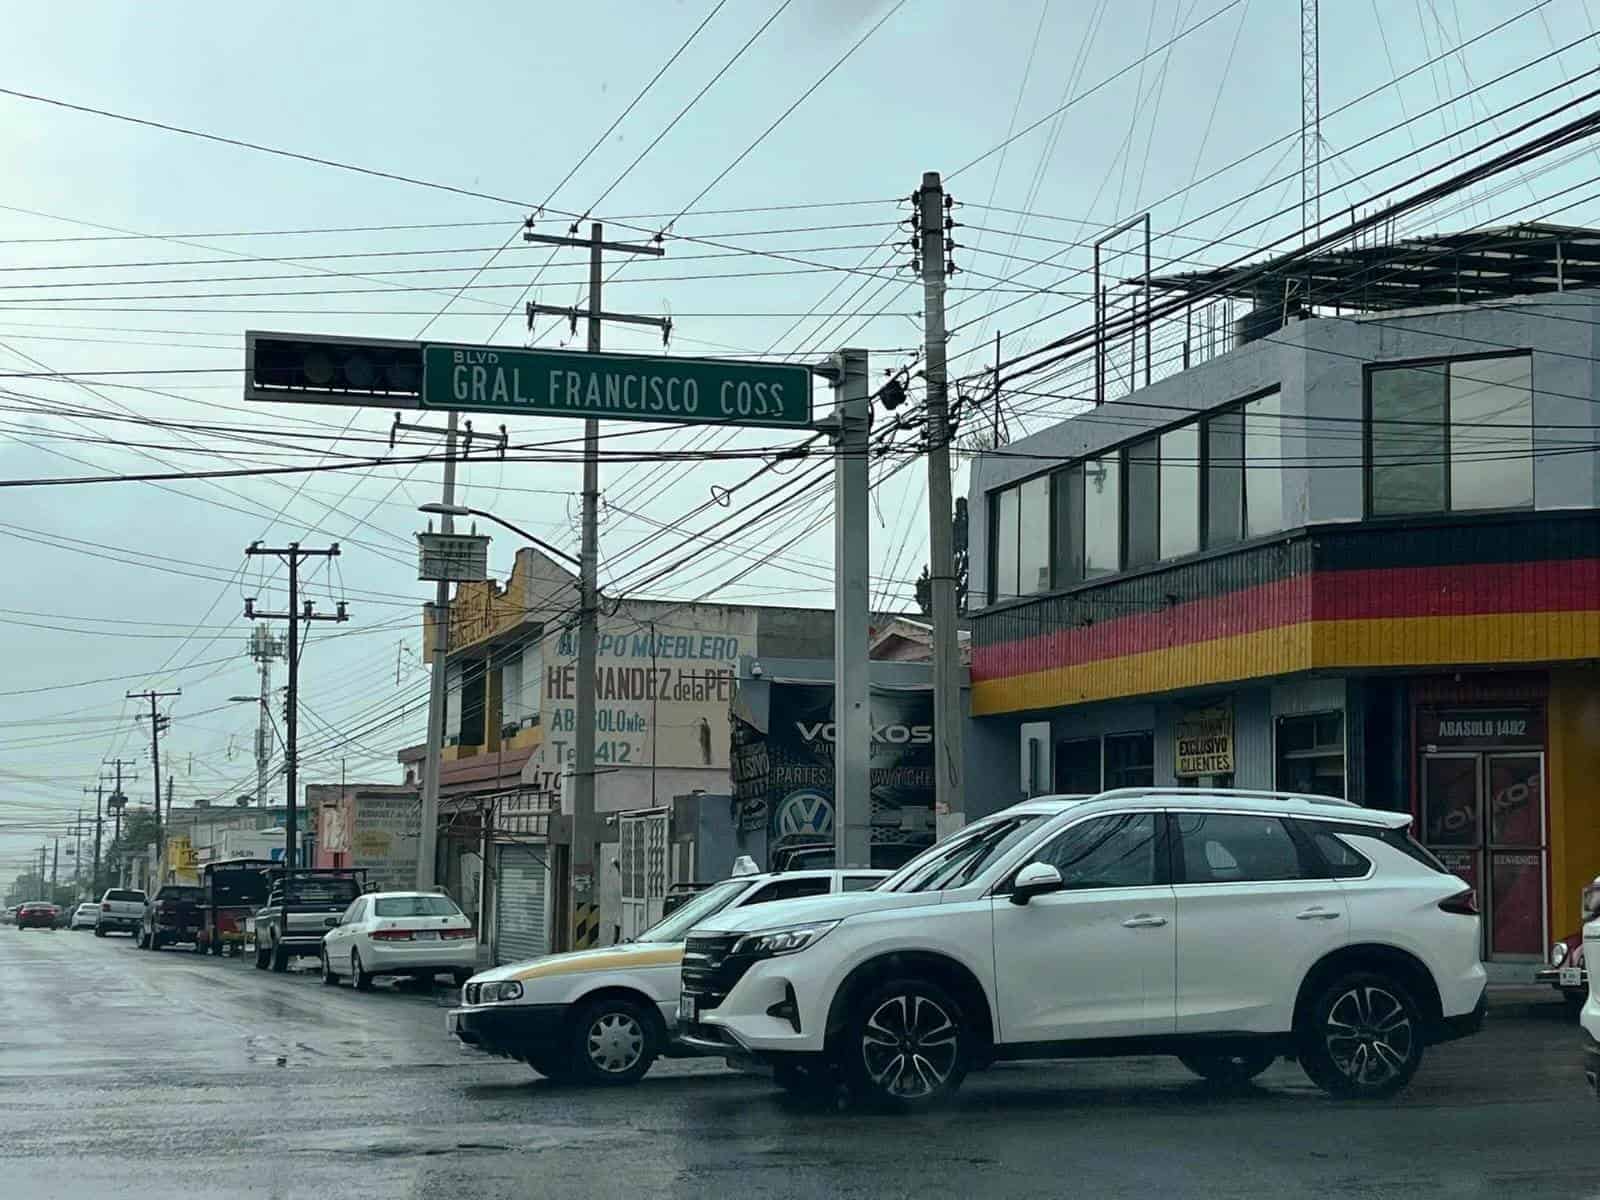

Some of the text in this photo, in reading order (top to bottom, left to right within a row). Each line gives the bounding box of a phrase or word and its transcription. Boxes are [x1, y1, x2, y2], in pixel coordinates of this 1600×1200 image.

[453, 364, 785, 418] GRAL. FRANCISCO COSS
[631, 634, 739, 660] MUEBLERO
[547, 665, 672, 701] HENANDEZ
[551, 708, 626, 733] ABOLO
[796, 720, 933, 744] VOKOS
